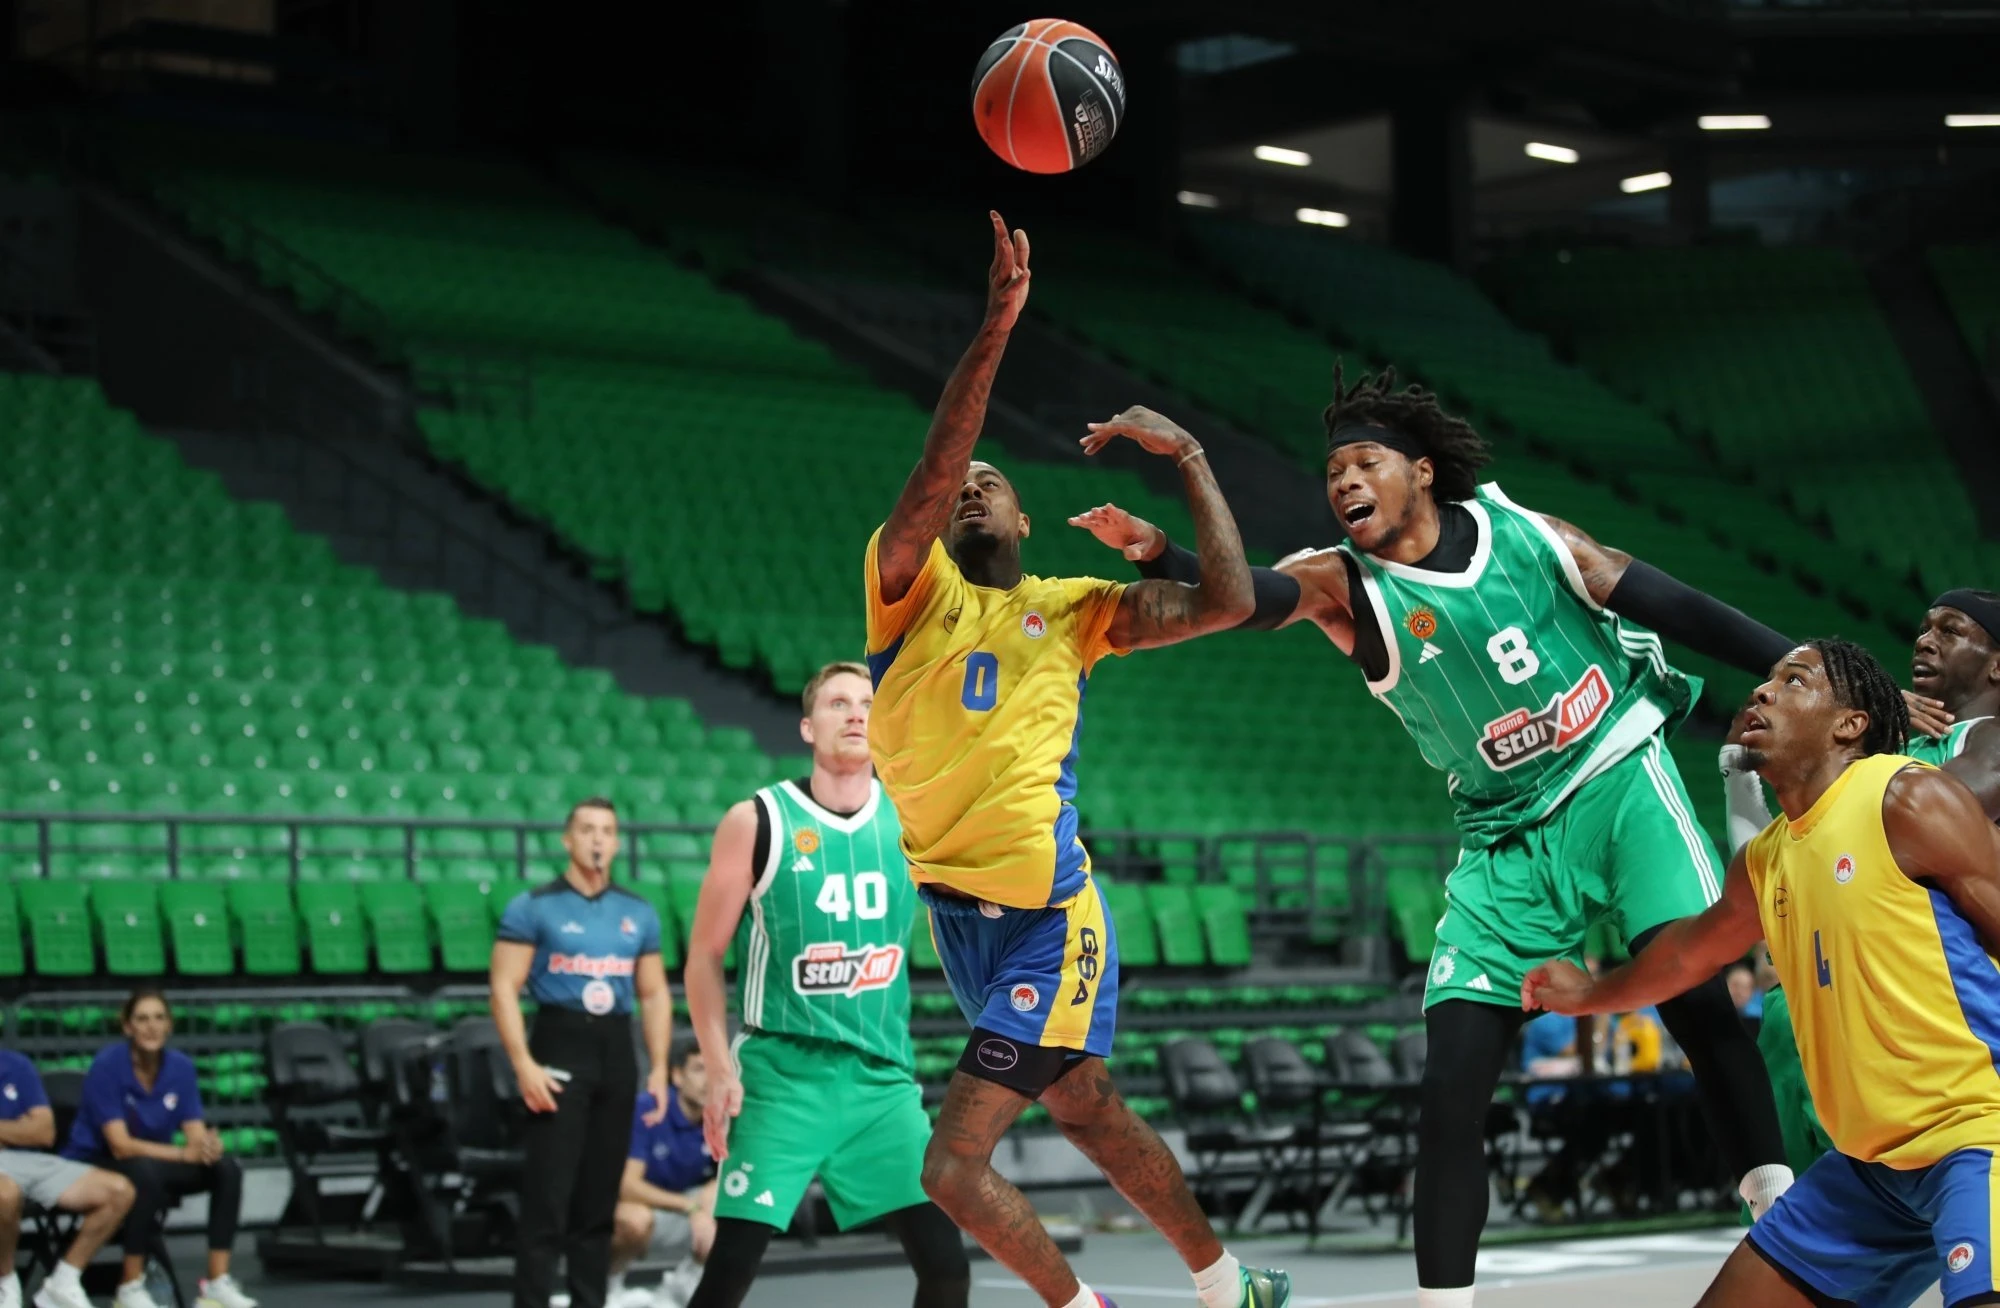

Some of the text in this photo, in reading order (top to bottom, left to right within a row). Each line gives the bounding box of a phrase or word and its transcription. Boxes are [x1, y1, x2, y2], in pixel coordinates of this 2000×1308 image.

[961, 651, 999, 712] 0
[1487, 626, 1540, 685] 8
[815, 871, 888, 922] 40
[1070, 927, 1099, 1006] GSA
[981, 1046, 1014, 1063] GSA
